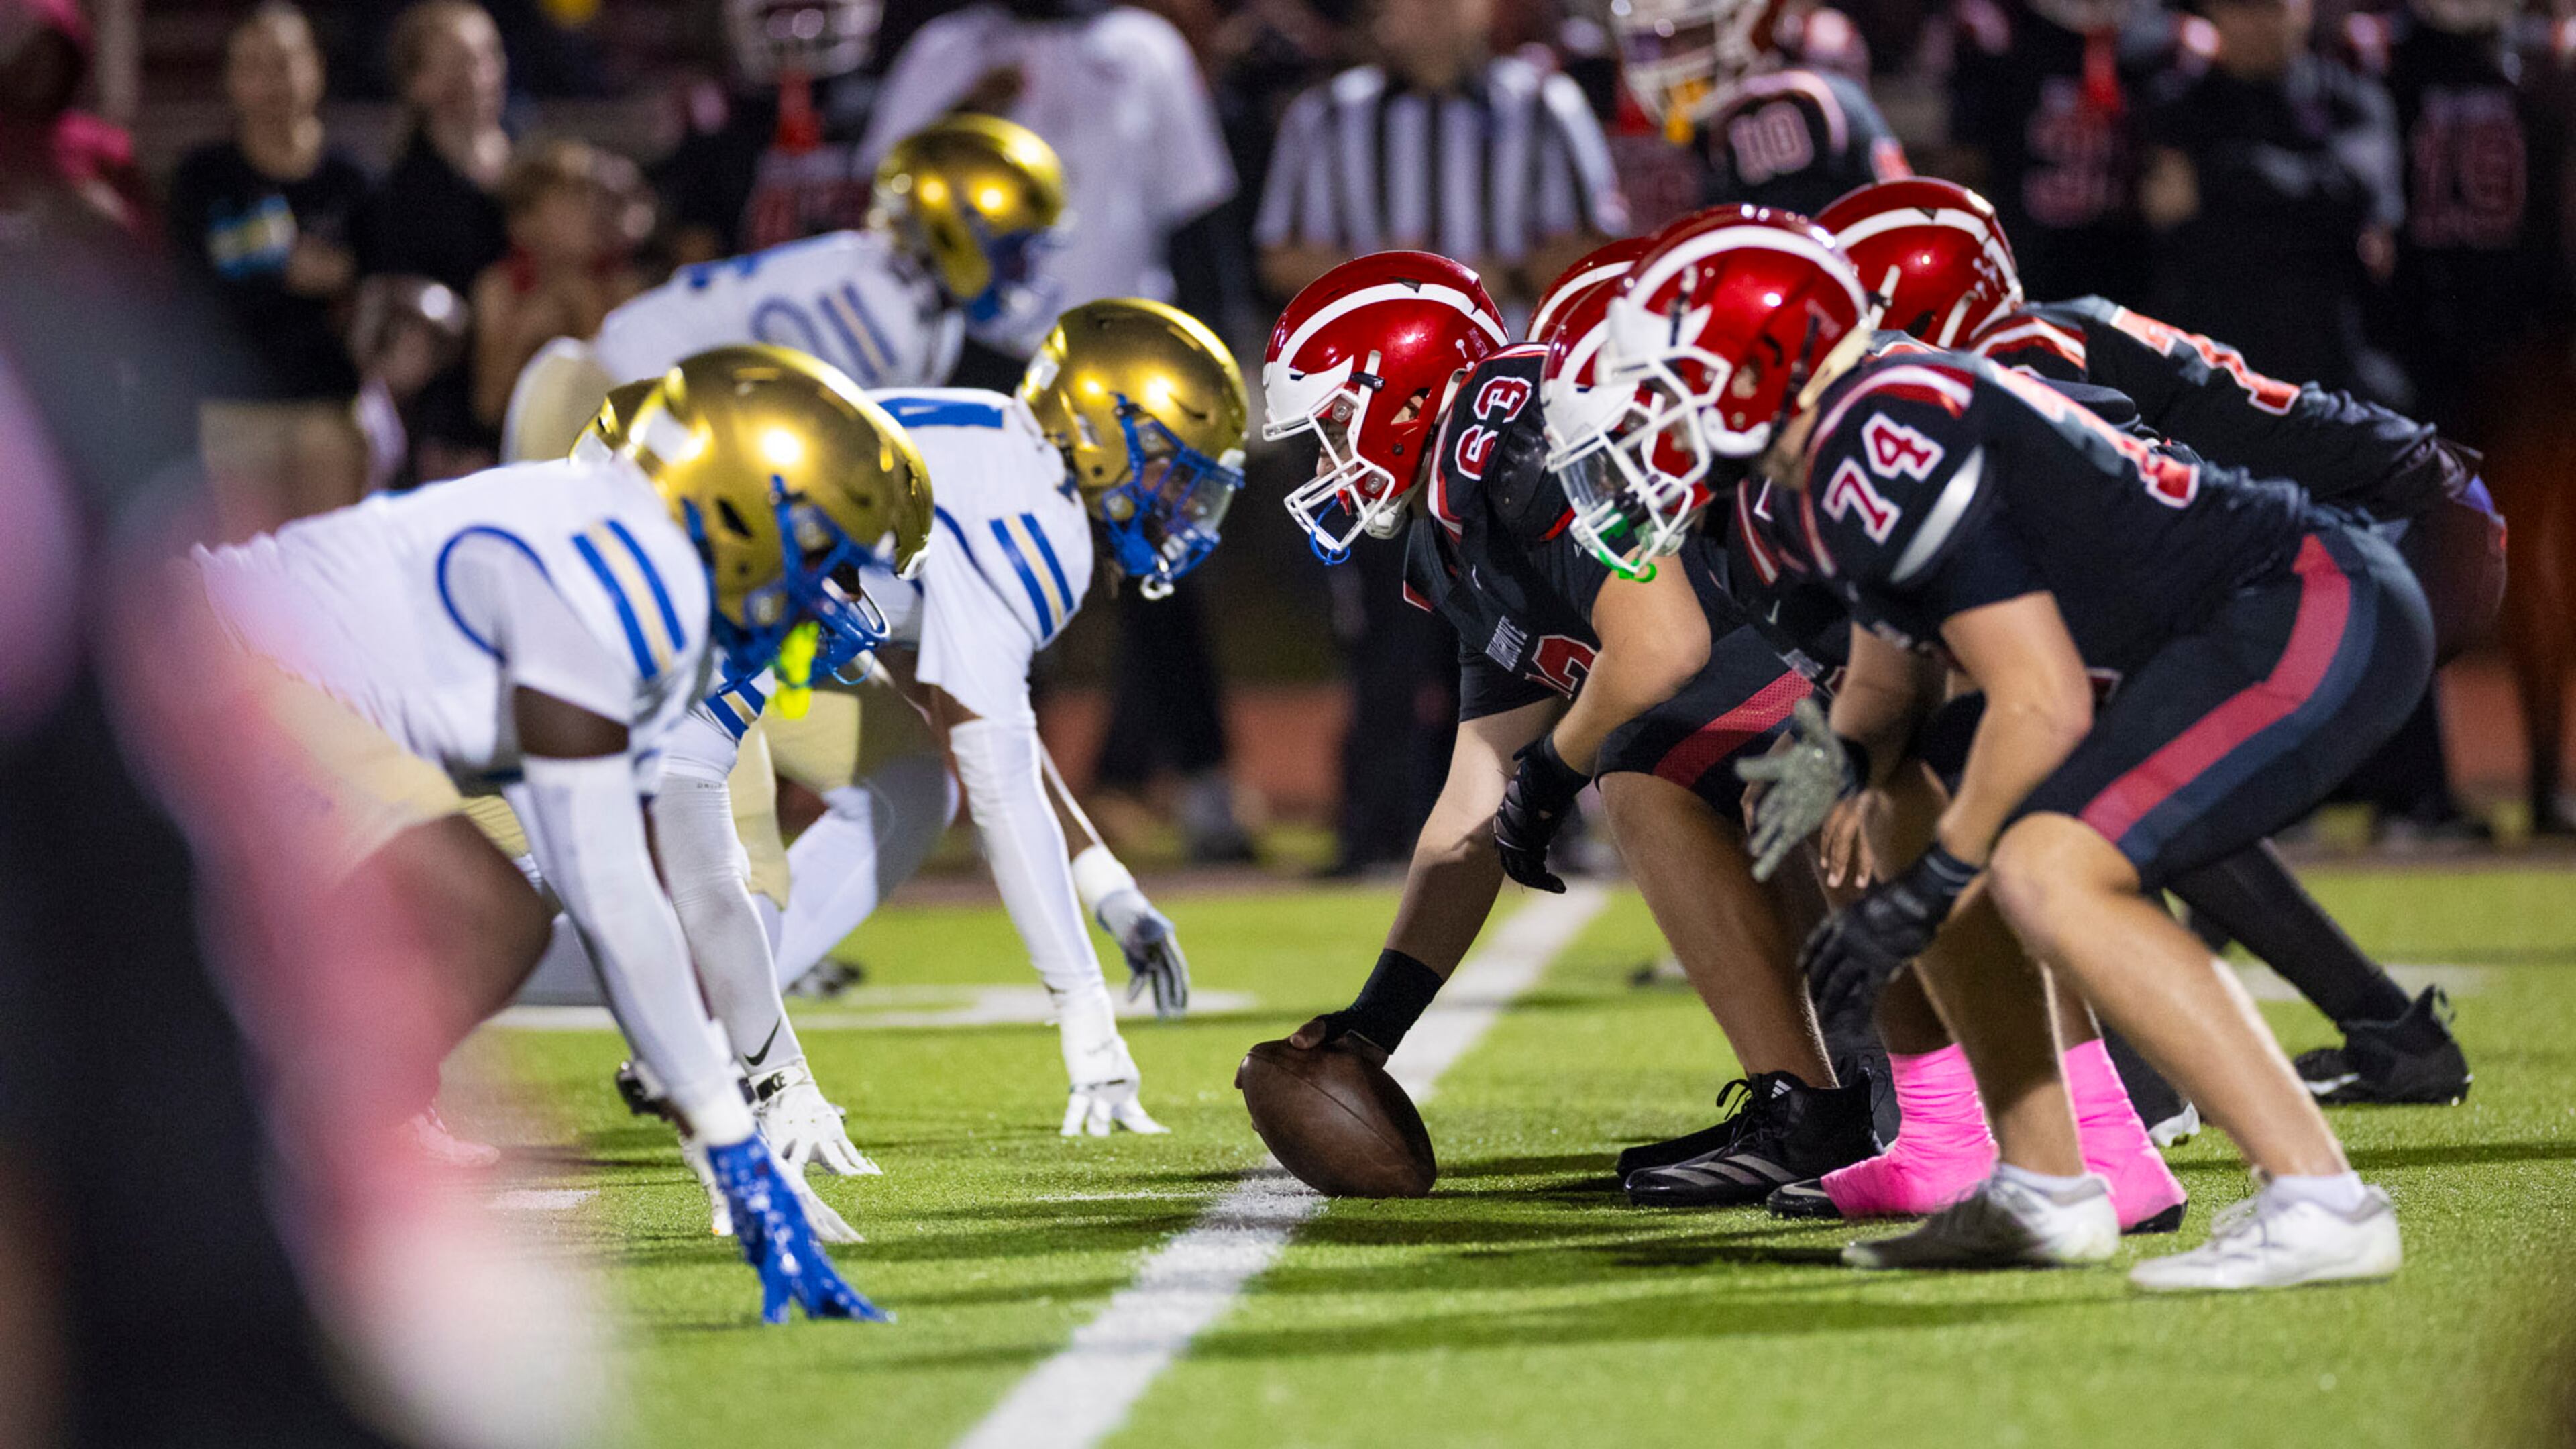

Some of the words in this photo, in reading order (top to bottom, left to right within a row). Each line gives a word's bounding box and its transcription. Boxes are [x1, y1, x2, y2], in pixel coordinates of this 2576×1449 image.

[1729, 101, 1814, 185] 10
[1455, 376, 1532, 481] 63
[1821, 410, 1945, 545] 74
